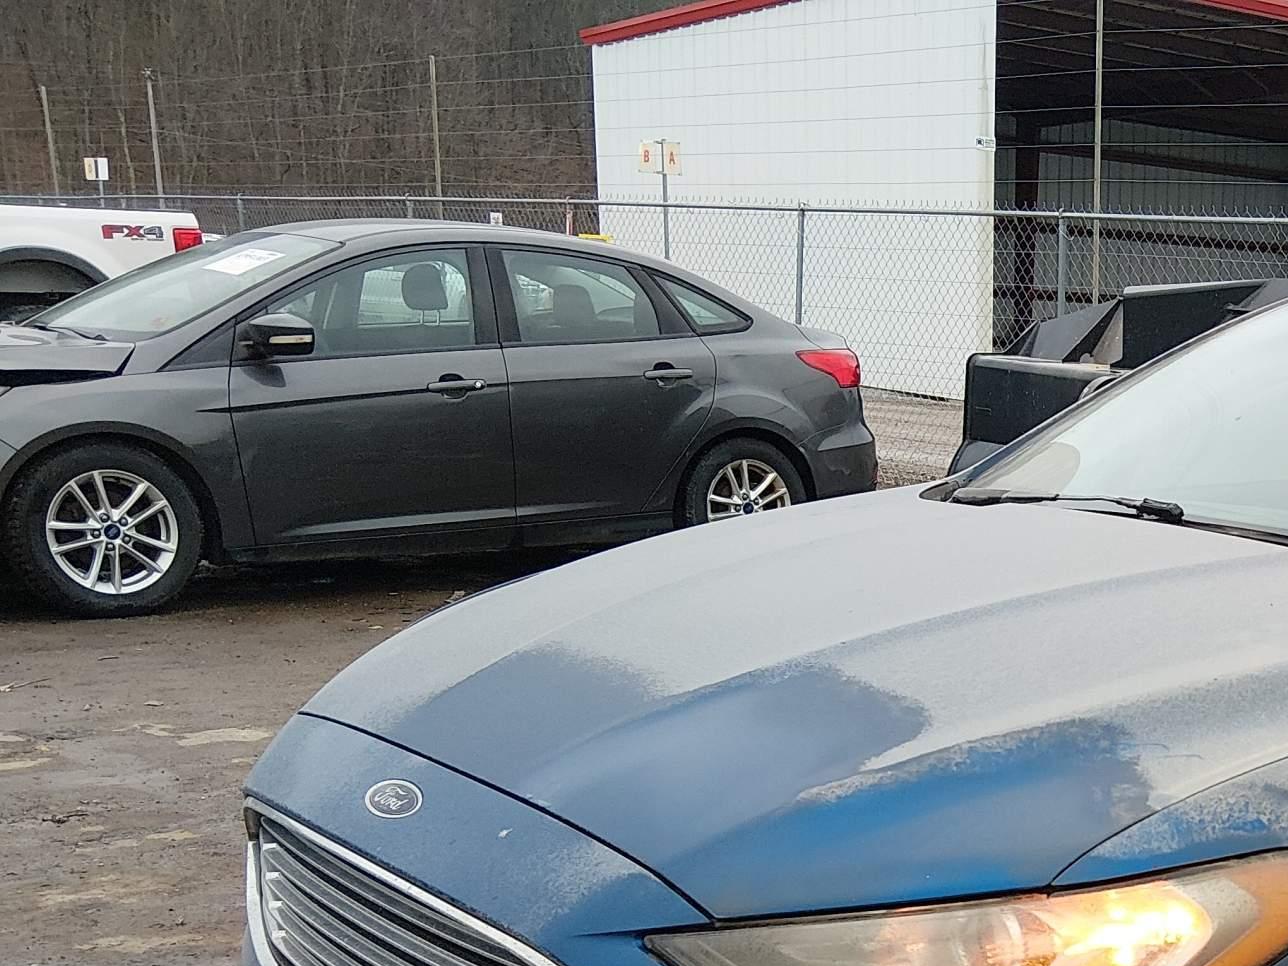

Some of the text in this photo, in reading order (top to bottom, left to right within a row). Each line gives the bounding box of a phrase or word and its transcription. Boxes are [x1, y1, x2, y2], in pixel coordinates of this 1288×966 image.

[644, 150, 650, 163] B
[669, 151, 676, 165] A
[101, 223, 164, 239] FX4
[373, 786, 410, 811] Ford
